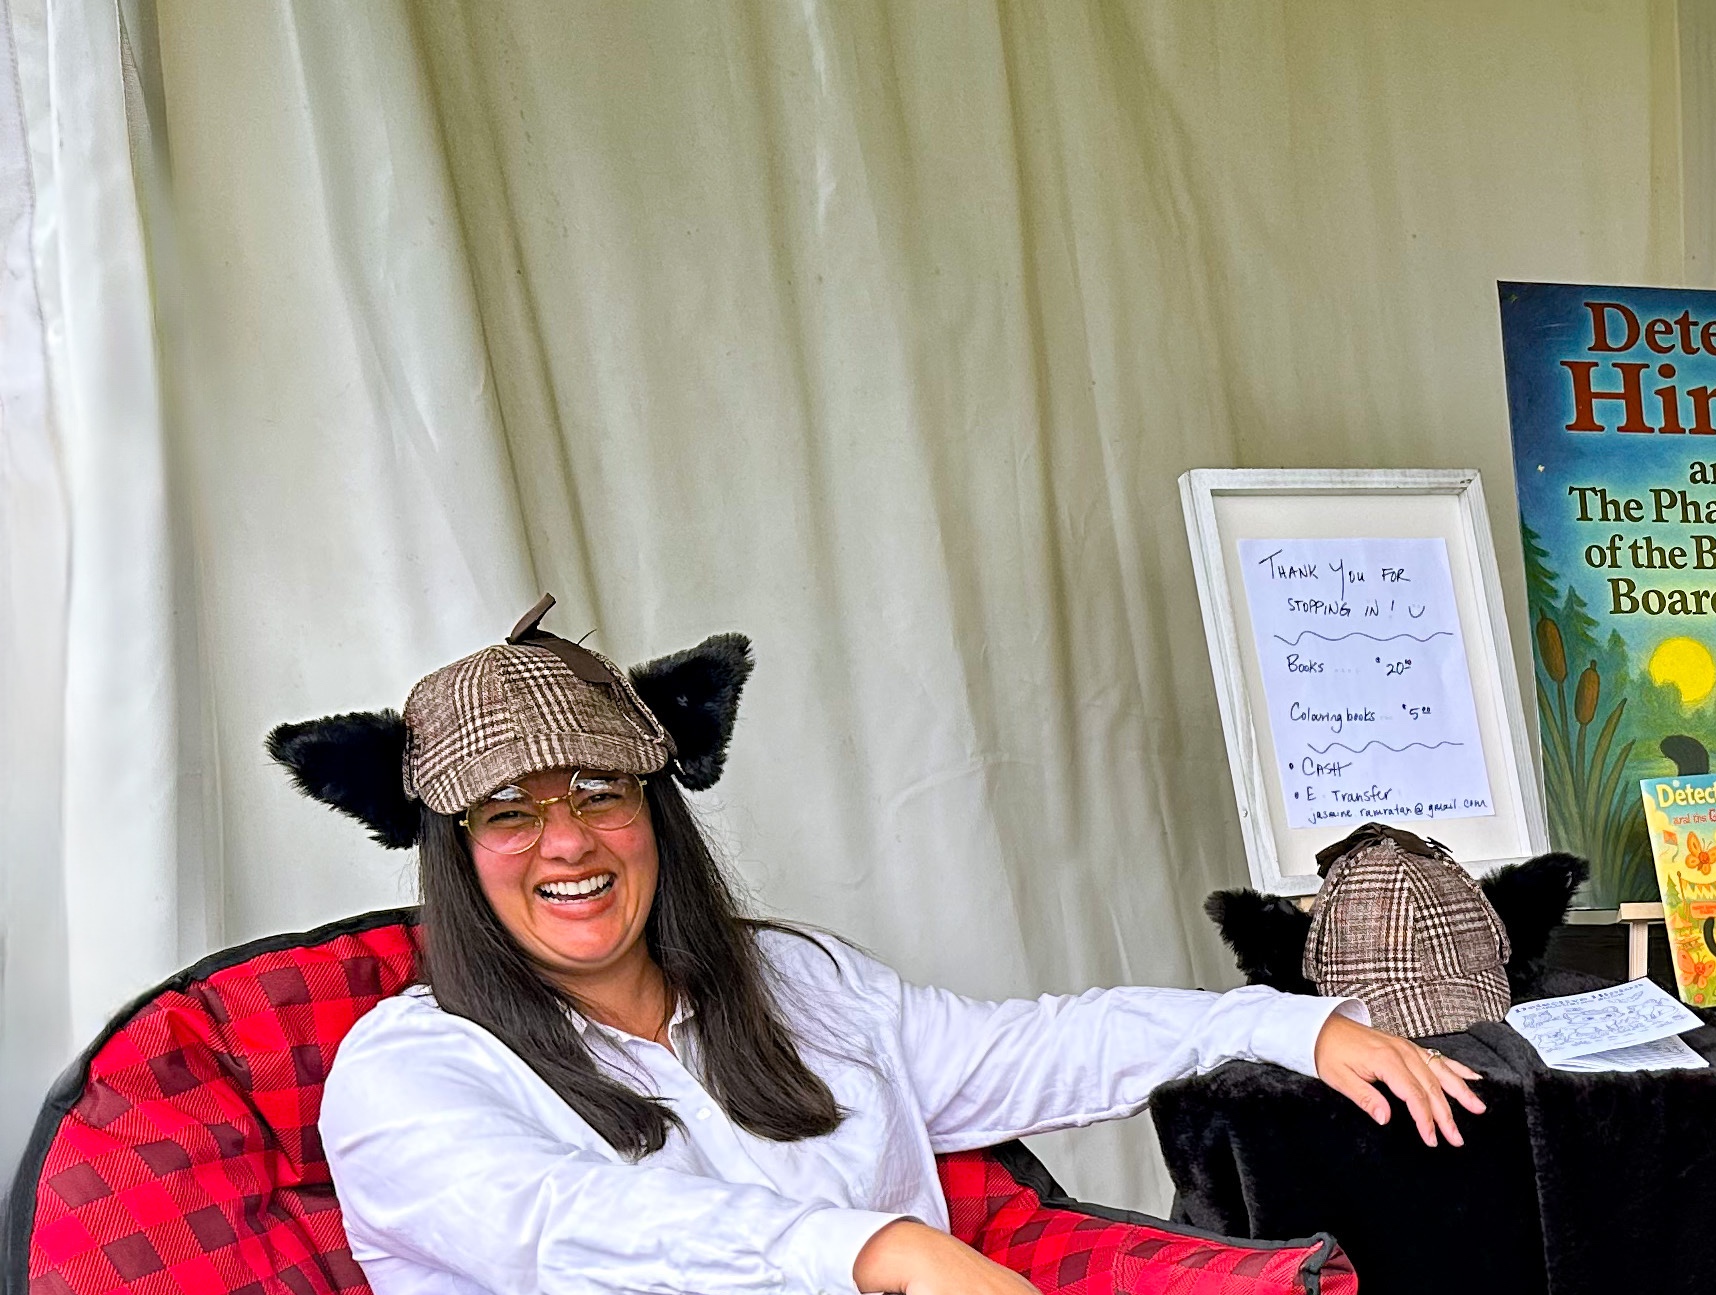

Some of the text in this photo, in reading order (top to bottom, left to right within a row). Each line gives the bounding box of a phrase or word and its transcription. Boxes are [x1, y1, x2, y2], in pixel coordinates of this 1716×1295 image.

[1568, 486, 1644, 524] The
[1258, 549, 1319, 579] THANK
[1381, 568, 1411, 582] FOR
[1584, 534, 1624, 569] of
[1629, 536, 1687, 570] the
[1287, 598, 1351, 617] STOPPING
[1286, 653, 1325, 674] Books
[1346, 707, 1376, 722] books
